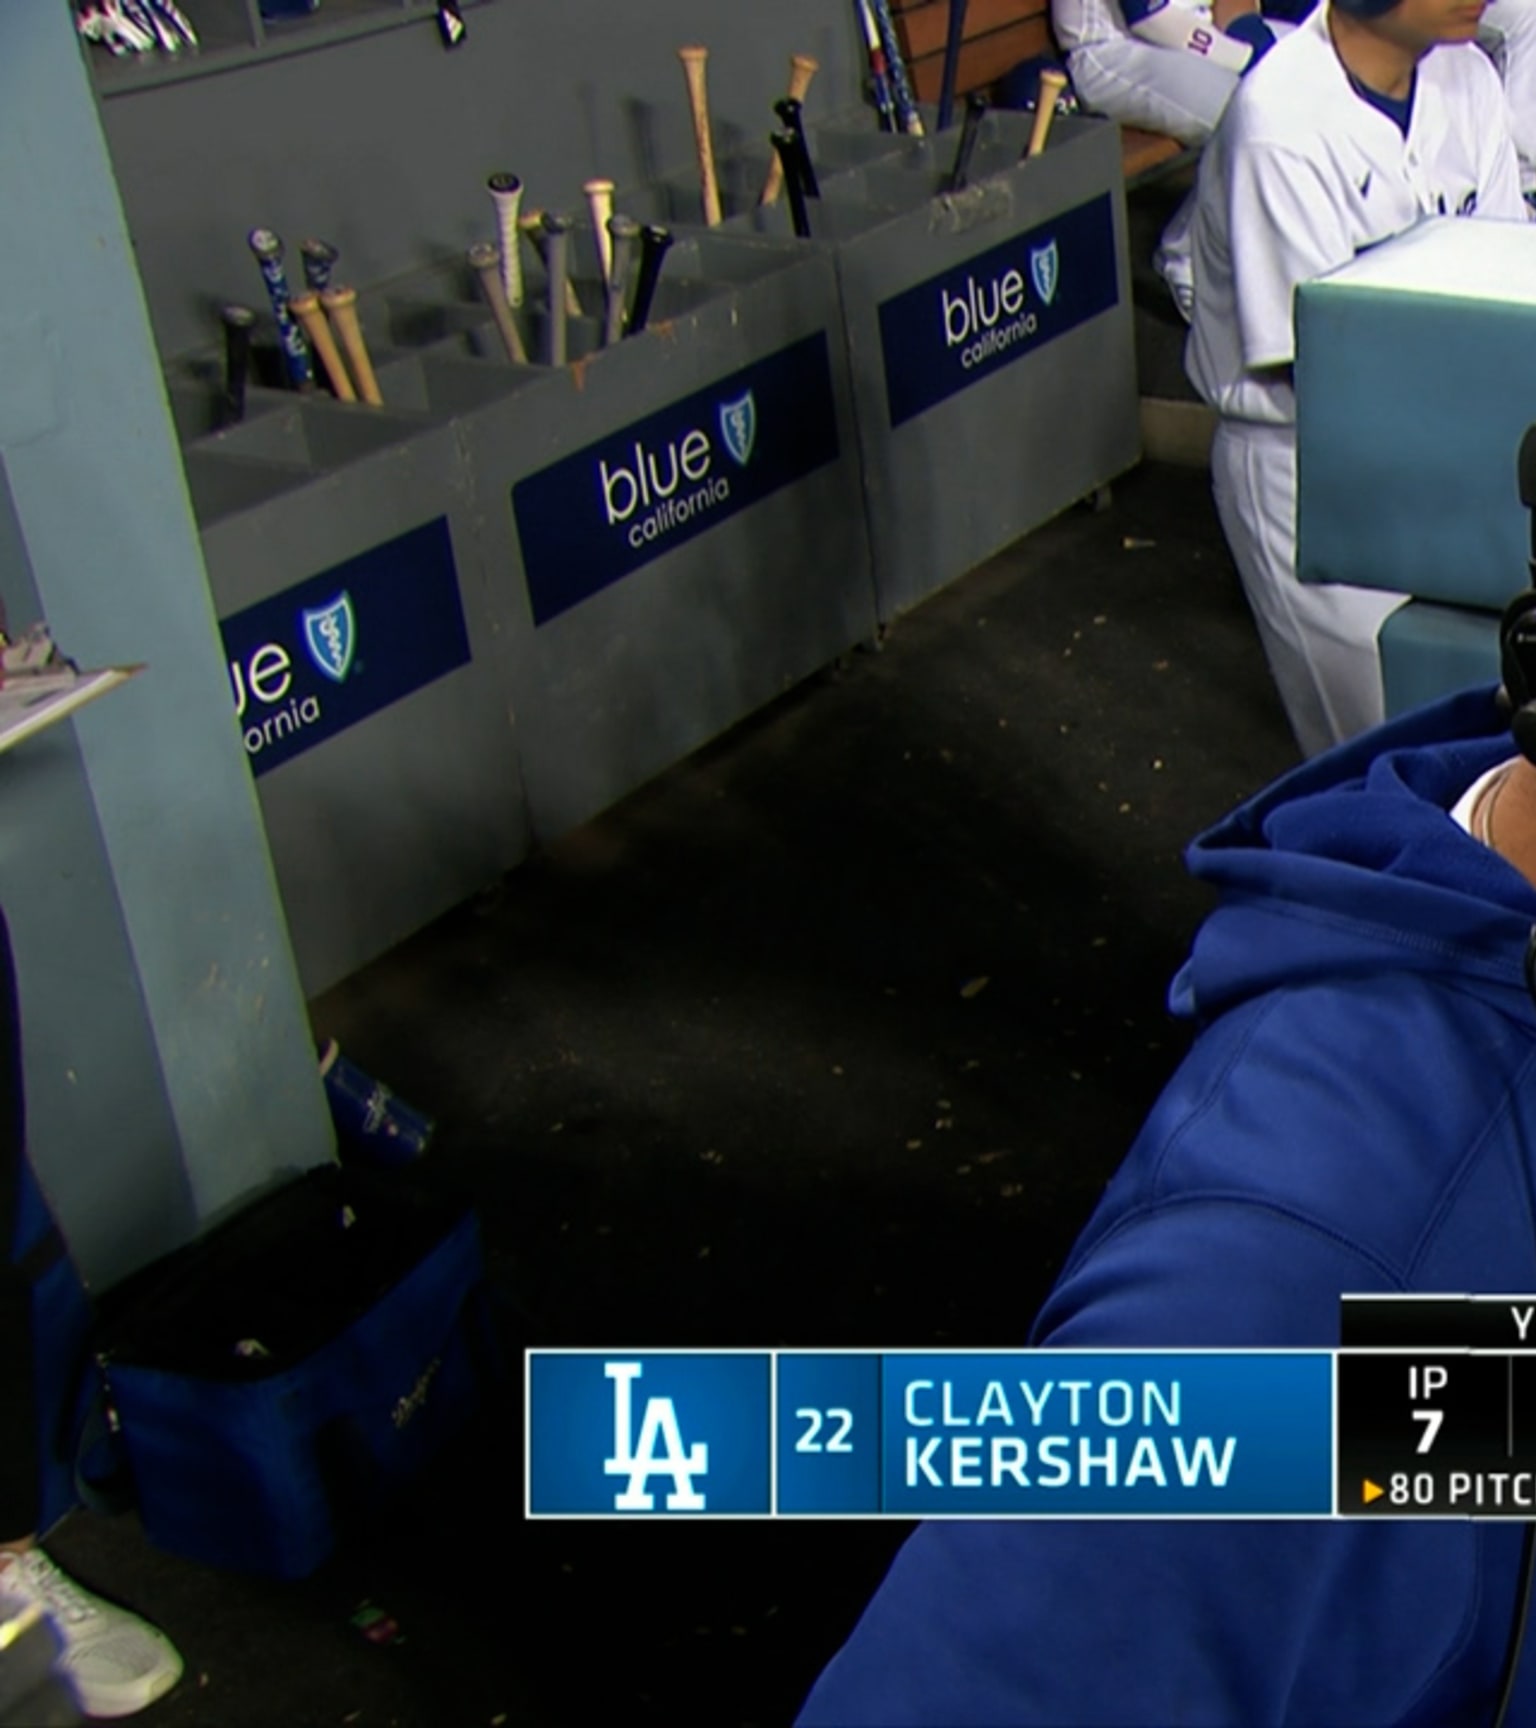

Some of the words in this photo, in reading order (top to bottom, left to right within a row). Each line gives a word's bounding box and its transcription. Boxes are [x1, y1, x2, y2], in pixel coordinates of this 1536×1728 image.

[1187, 27, 1213, 56] 10
[942, 269, 1024, 346] blue
[961, 312, 1037, 369] california
[600, 429, 711, 525] blue
[628, 476, 729, 548] california
[243, 696, 320, 753] ornia
